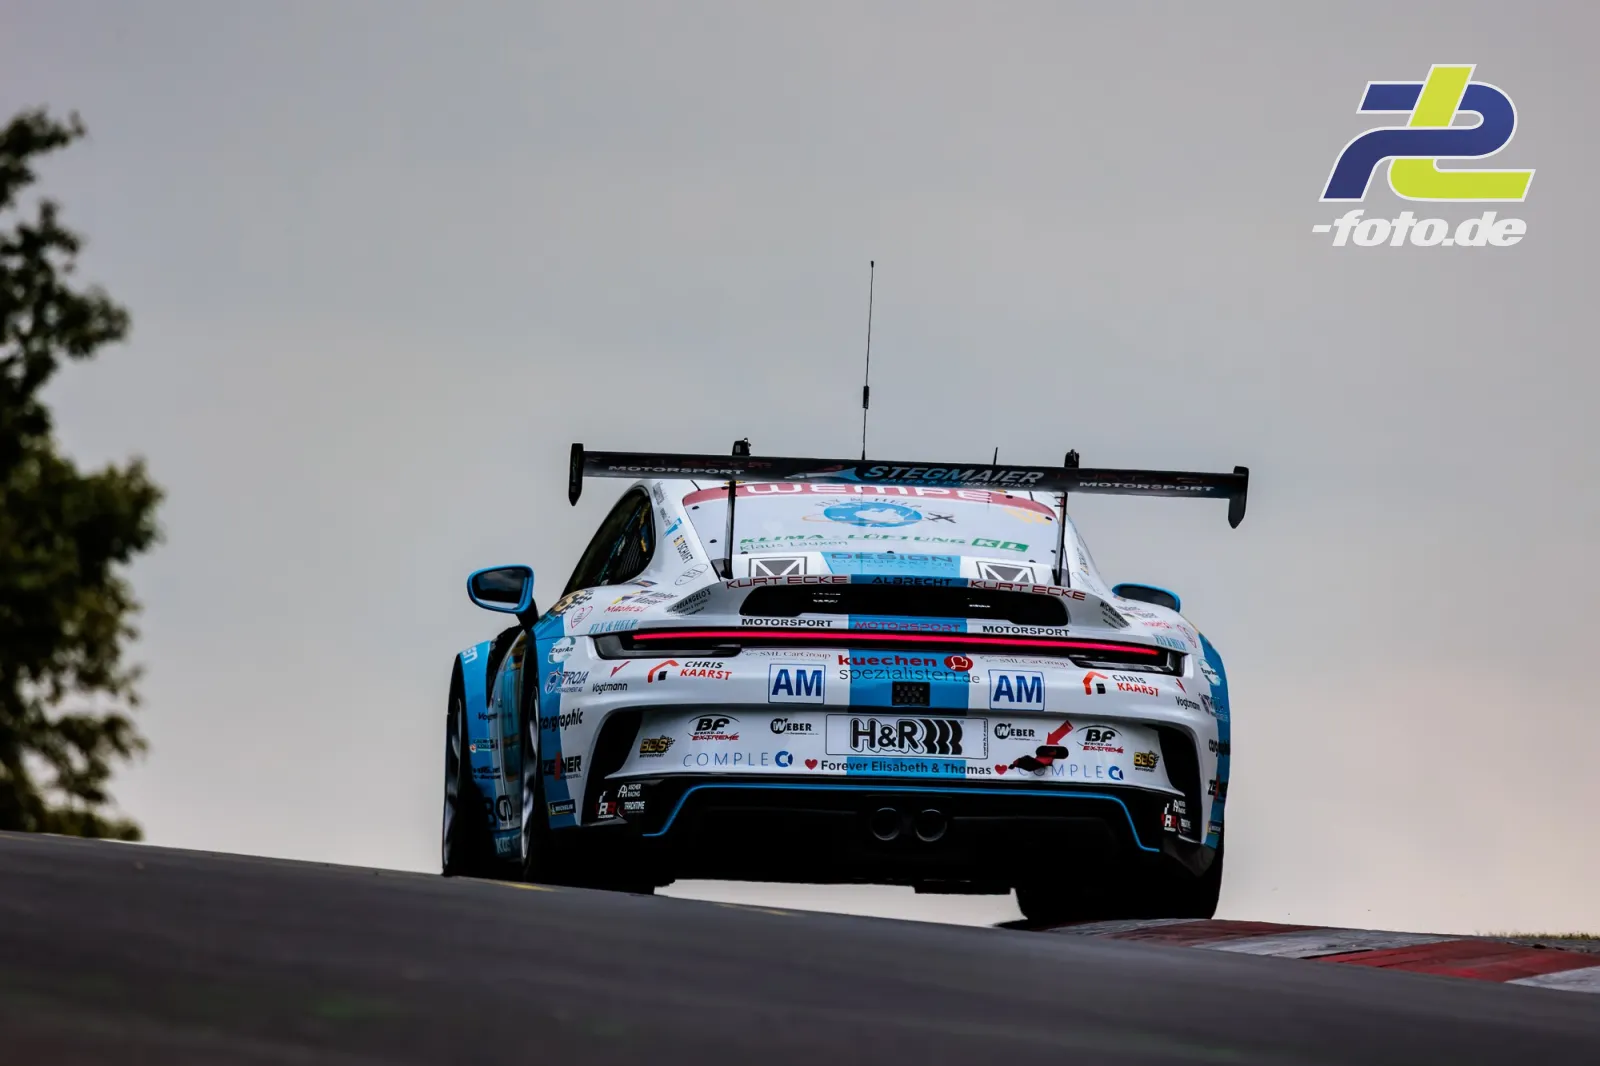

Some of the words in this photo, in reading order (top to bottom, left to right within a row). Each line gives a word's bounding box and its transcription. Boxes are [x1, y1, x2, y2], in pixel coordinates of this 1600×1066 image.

[608, 465, 745, 475] MOTORSPORT
[864, 466, 1044, 484] STEGMAIER
[1079, 482, 1214, 492] MOTORSPORT
[831, 553, 953, 563] DESIGN
[726, 576, 782, 589] KURT
[786, 575, 848, 585] ECKE
[872, 577, 953, 587] ALBRECHT
[970, 580, 1024, 594] KURT
[1031, 586, 1087, 601] ECKE
[741, 618, 833, 627] MOTORSPORT
[854, 621, 960, 632] MOTORSPORT
[982, 626, 1070, 637] MOTORSPORT
[684, 661, 724, 671] CHRIS
[838, 655, 937, 668] kuechen
[679, 669, 732, 681] KAARST
[839, 667, 981, 684] spezialisten.de
[1112, 674, 1146, 684] CHRIS
[592, 682, 628, 695] Vogtmann
[771, 669, 823, 697] AM
[992, 675, 1043, 704] AM
[1116, 683, 1159, 697] KAARST
[695, 718, 731, 732] BF
[770, 717, 813, 735] WEBER
[994, 723, 1036, 741] WEBER
[850, 717, 925, 755] H&R
[1085, 729, 1116, 743] BF
[820, 761, 868, 773] Forever
[871, 761, 928, 774] Elisabeth
[931, 764, 939, 774] &
[944, 763, 992, 776] Thomas
